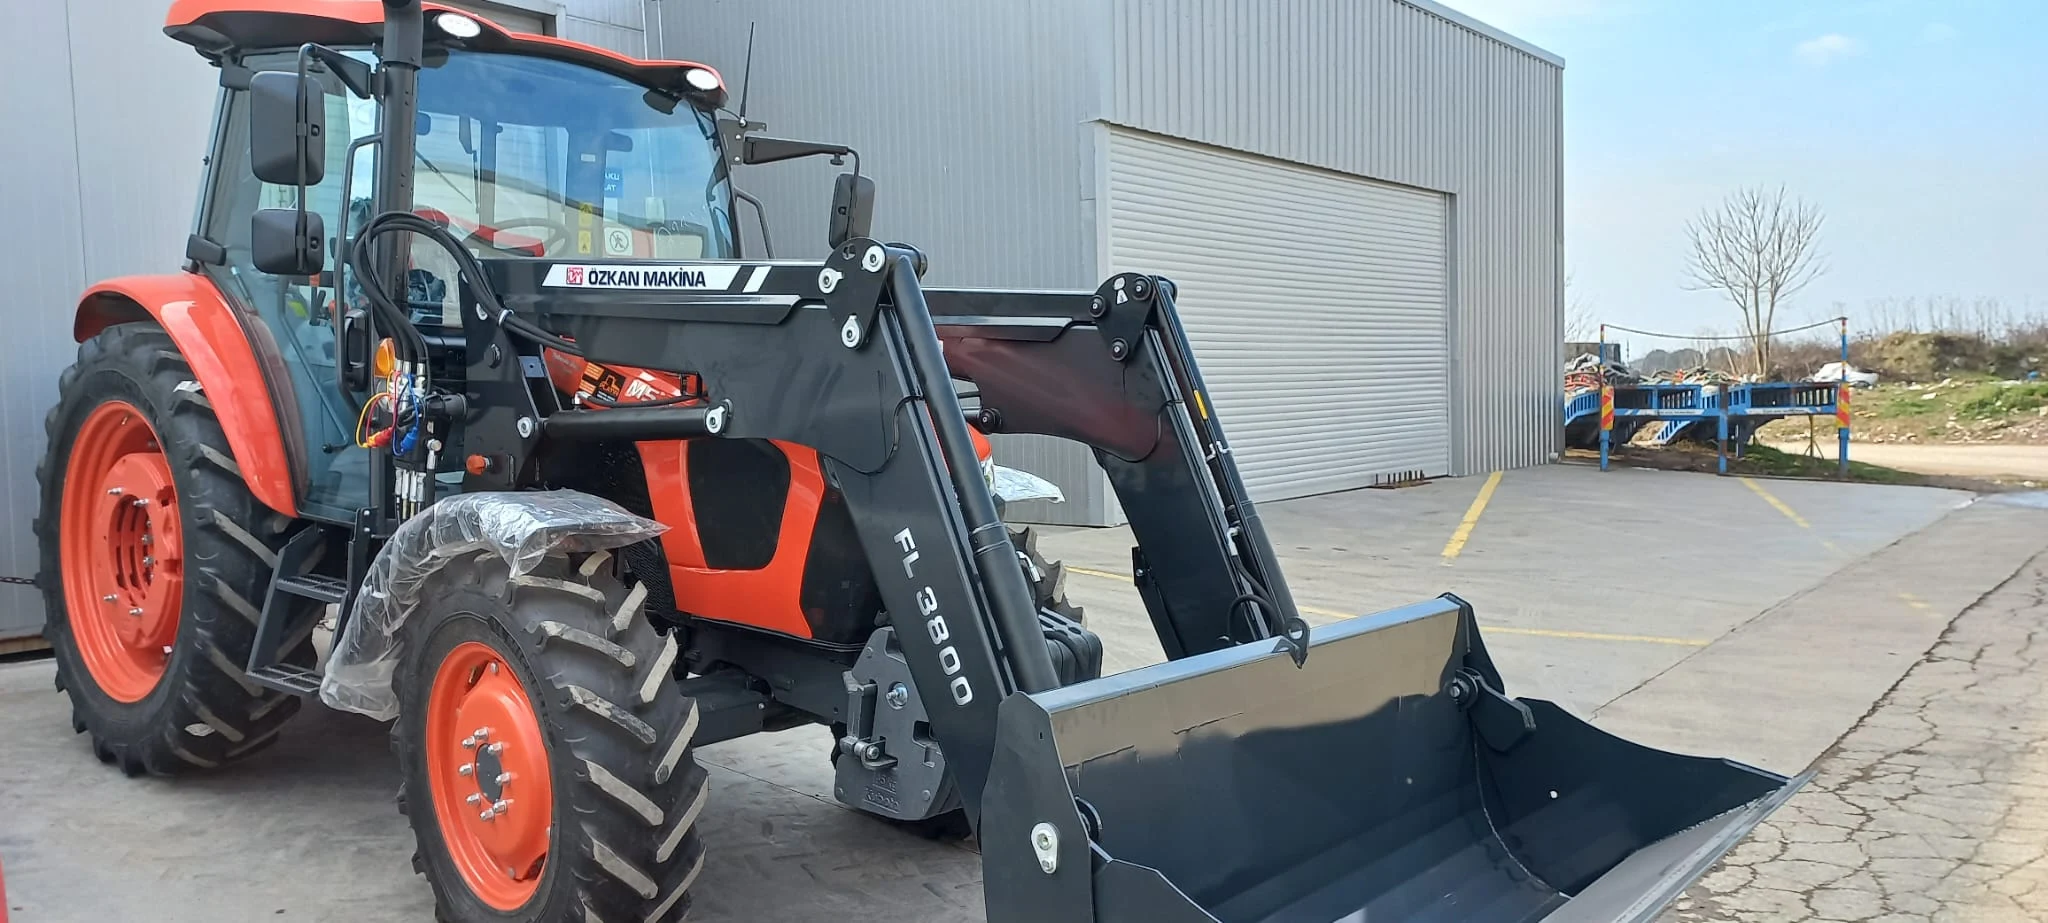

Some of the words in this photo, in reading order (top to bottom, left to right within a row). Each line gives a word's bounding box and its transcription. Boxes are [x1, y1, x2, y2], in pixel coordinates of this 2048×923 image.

[588, 267, 640, 286] ÖZKAN
[643, 267, 707, 287] MAKİNA
[894, 527, 920, 579] FL
[916, 586, 973, 706] 3800
